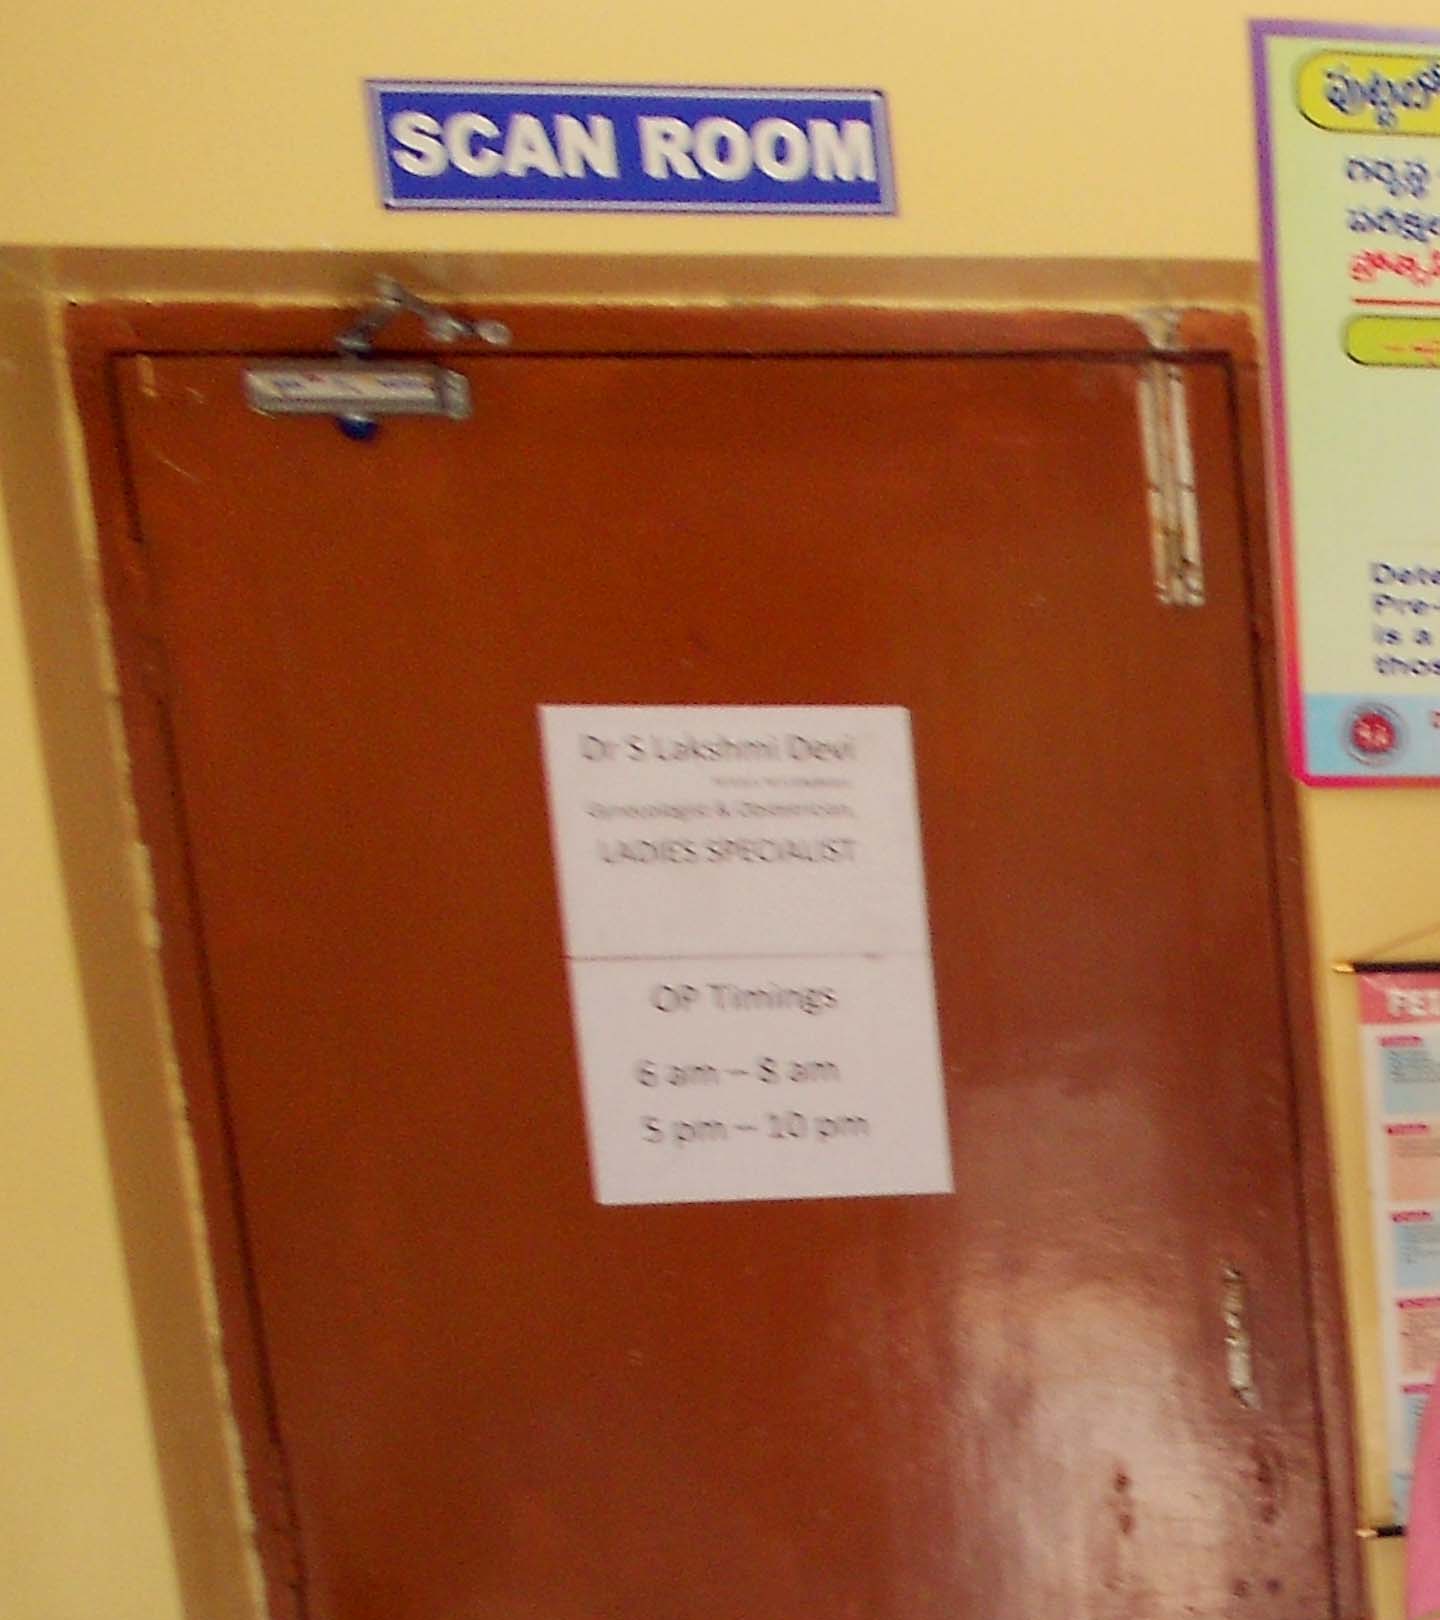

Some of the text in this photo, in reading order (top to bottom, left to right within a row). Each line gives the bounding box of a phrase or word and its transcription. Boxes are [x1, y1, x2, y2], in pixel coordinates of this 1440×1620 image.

[391, 111, 877, 183] SCAN ROOM
[1374, 624, 1402, 645] is
[1413, 630, 1432, 646] a
[653, 732, 779, 763] Lakshmi
[789, 732, 857, 762] Devi
[599, 838, 856, 865] LADIES SPECIALIST
[705, 982, 840, 1016] Timings
[664, 1064, 720, 1087] am
[787, 1060, 841, 1084] am
[674, 1120, 729, 1149] pm
[766, 1110, 809, 1140] 10
[815, 1114, 870, 1144] pm
